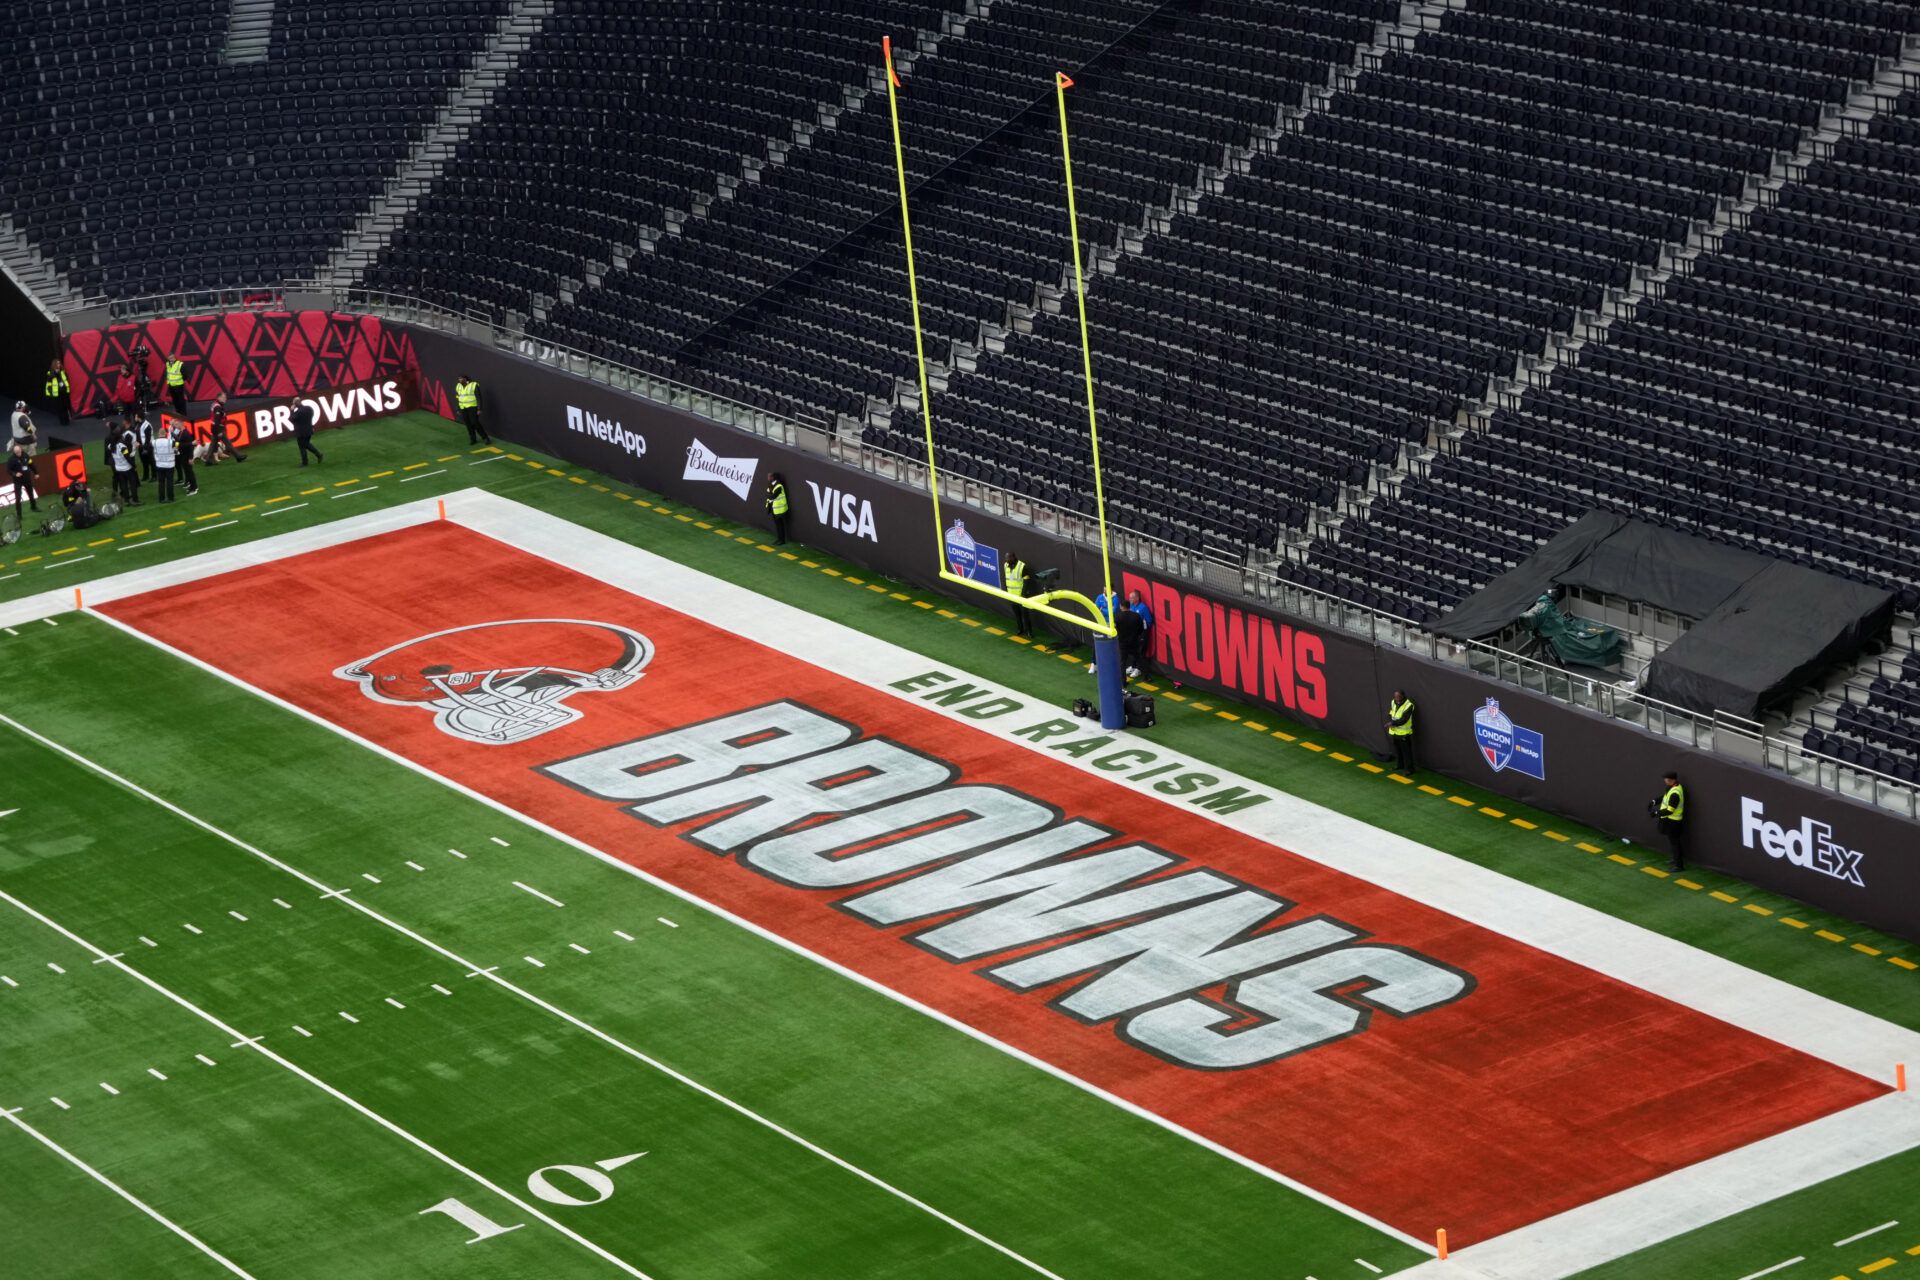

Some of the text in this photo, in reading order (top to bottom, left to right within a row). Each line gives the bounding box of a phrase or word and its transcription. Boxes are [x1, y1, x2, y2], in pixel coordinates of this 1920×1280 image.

[586, 411, 646, 458] NetApp
[686, 447, 753, 485] Budweiser
[805, 480, 878, 543] VISA
[948, 546, 974, 561] LONDON
[888, 670, 1274, 815] END RACISM
[1477, 727, 1511, 746] LONDON
[1741, 796, 1865, 887] FedEx
[529, 698, 1477, 1071] BROWNS
